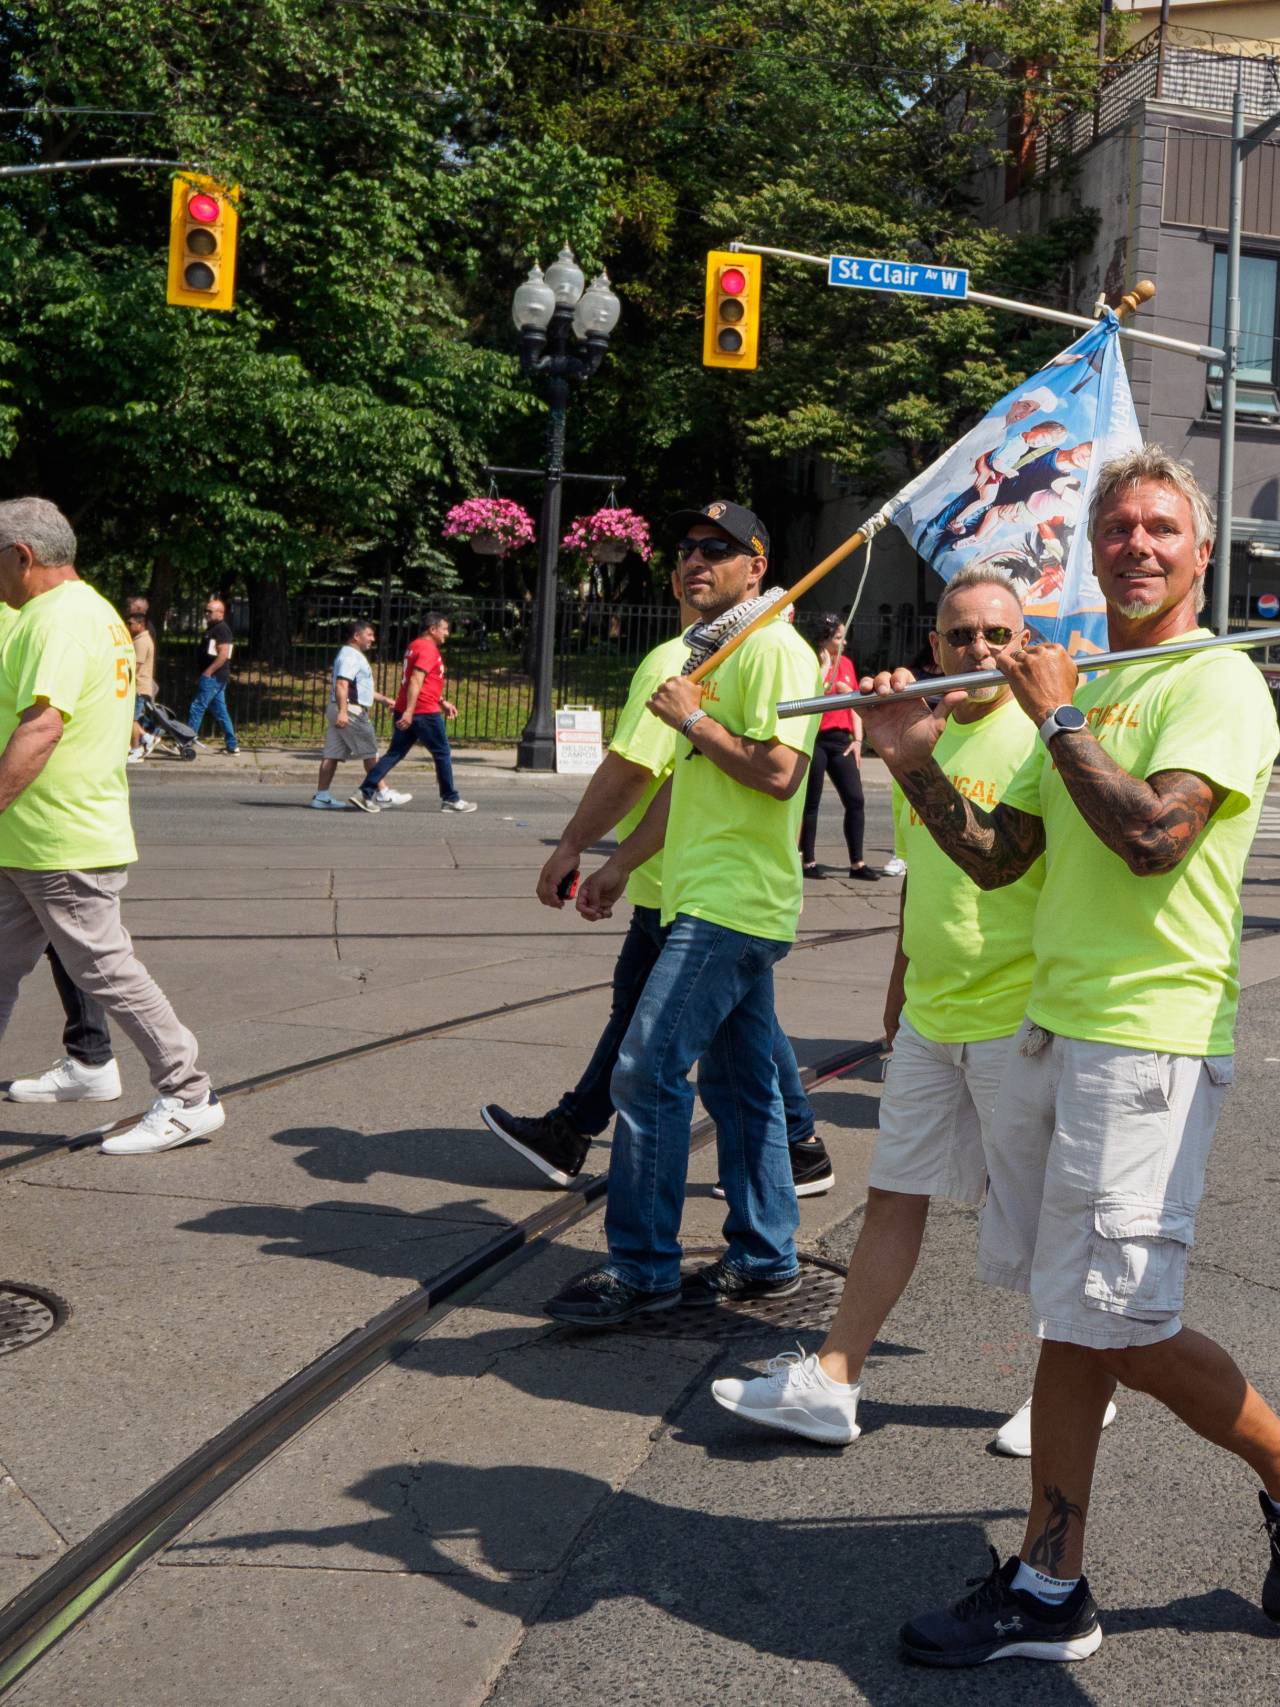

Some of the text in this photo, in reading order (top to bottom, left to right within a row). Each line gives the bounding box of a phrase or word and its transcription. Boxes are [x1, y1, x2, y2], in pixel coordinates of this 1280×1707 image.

[838, 259, 958, 291] St. Clair Av W
